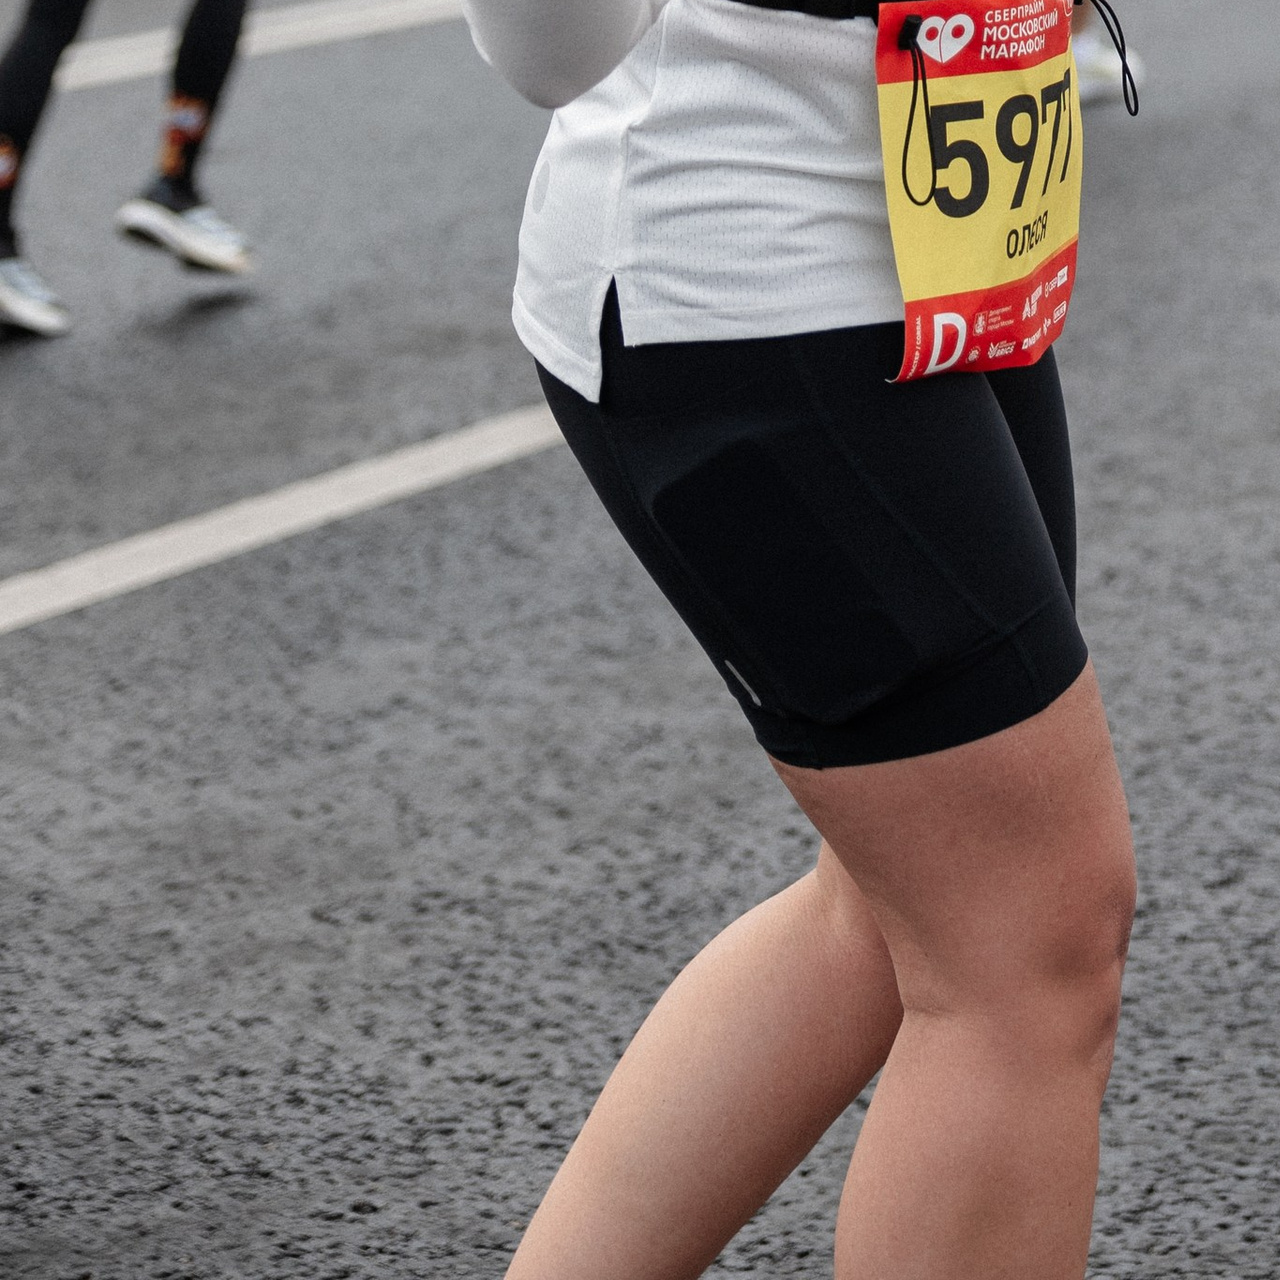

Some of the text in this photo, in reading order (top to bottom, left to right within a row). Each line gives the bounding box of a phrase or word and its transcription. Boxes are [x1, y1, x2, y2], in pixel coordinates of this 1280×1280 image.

[982, 8, 1058, 42] МОСКОВСКИЙ
[985, 0, 1045, 23] СБЕРПРАЙМ
[980, 34, 1046, 60] МАРАФОН
[930, 67, 1072, 218] 5977
[1006, 209, 1049, 259] ОЛЕСЯ
[923, 312, 967, 375] D
[906, 350, 920, 379] ЛАСТЕР
